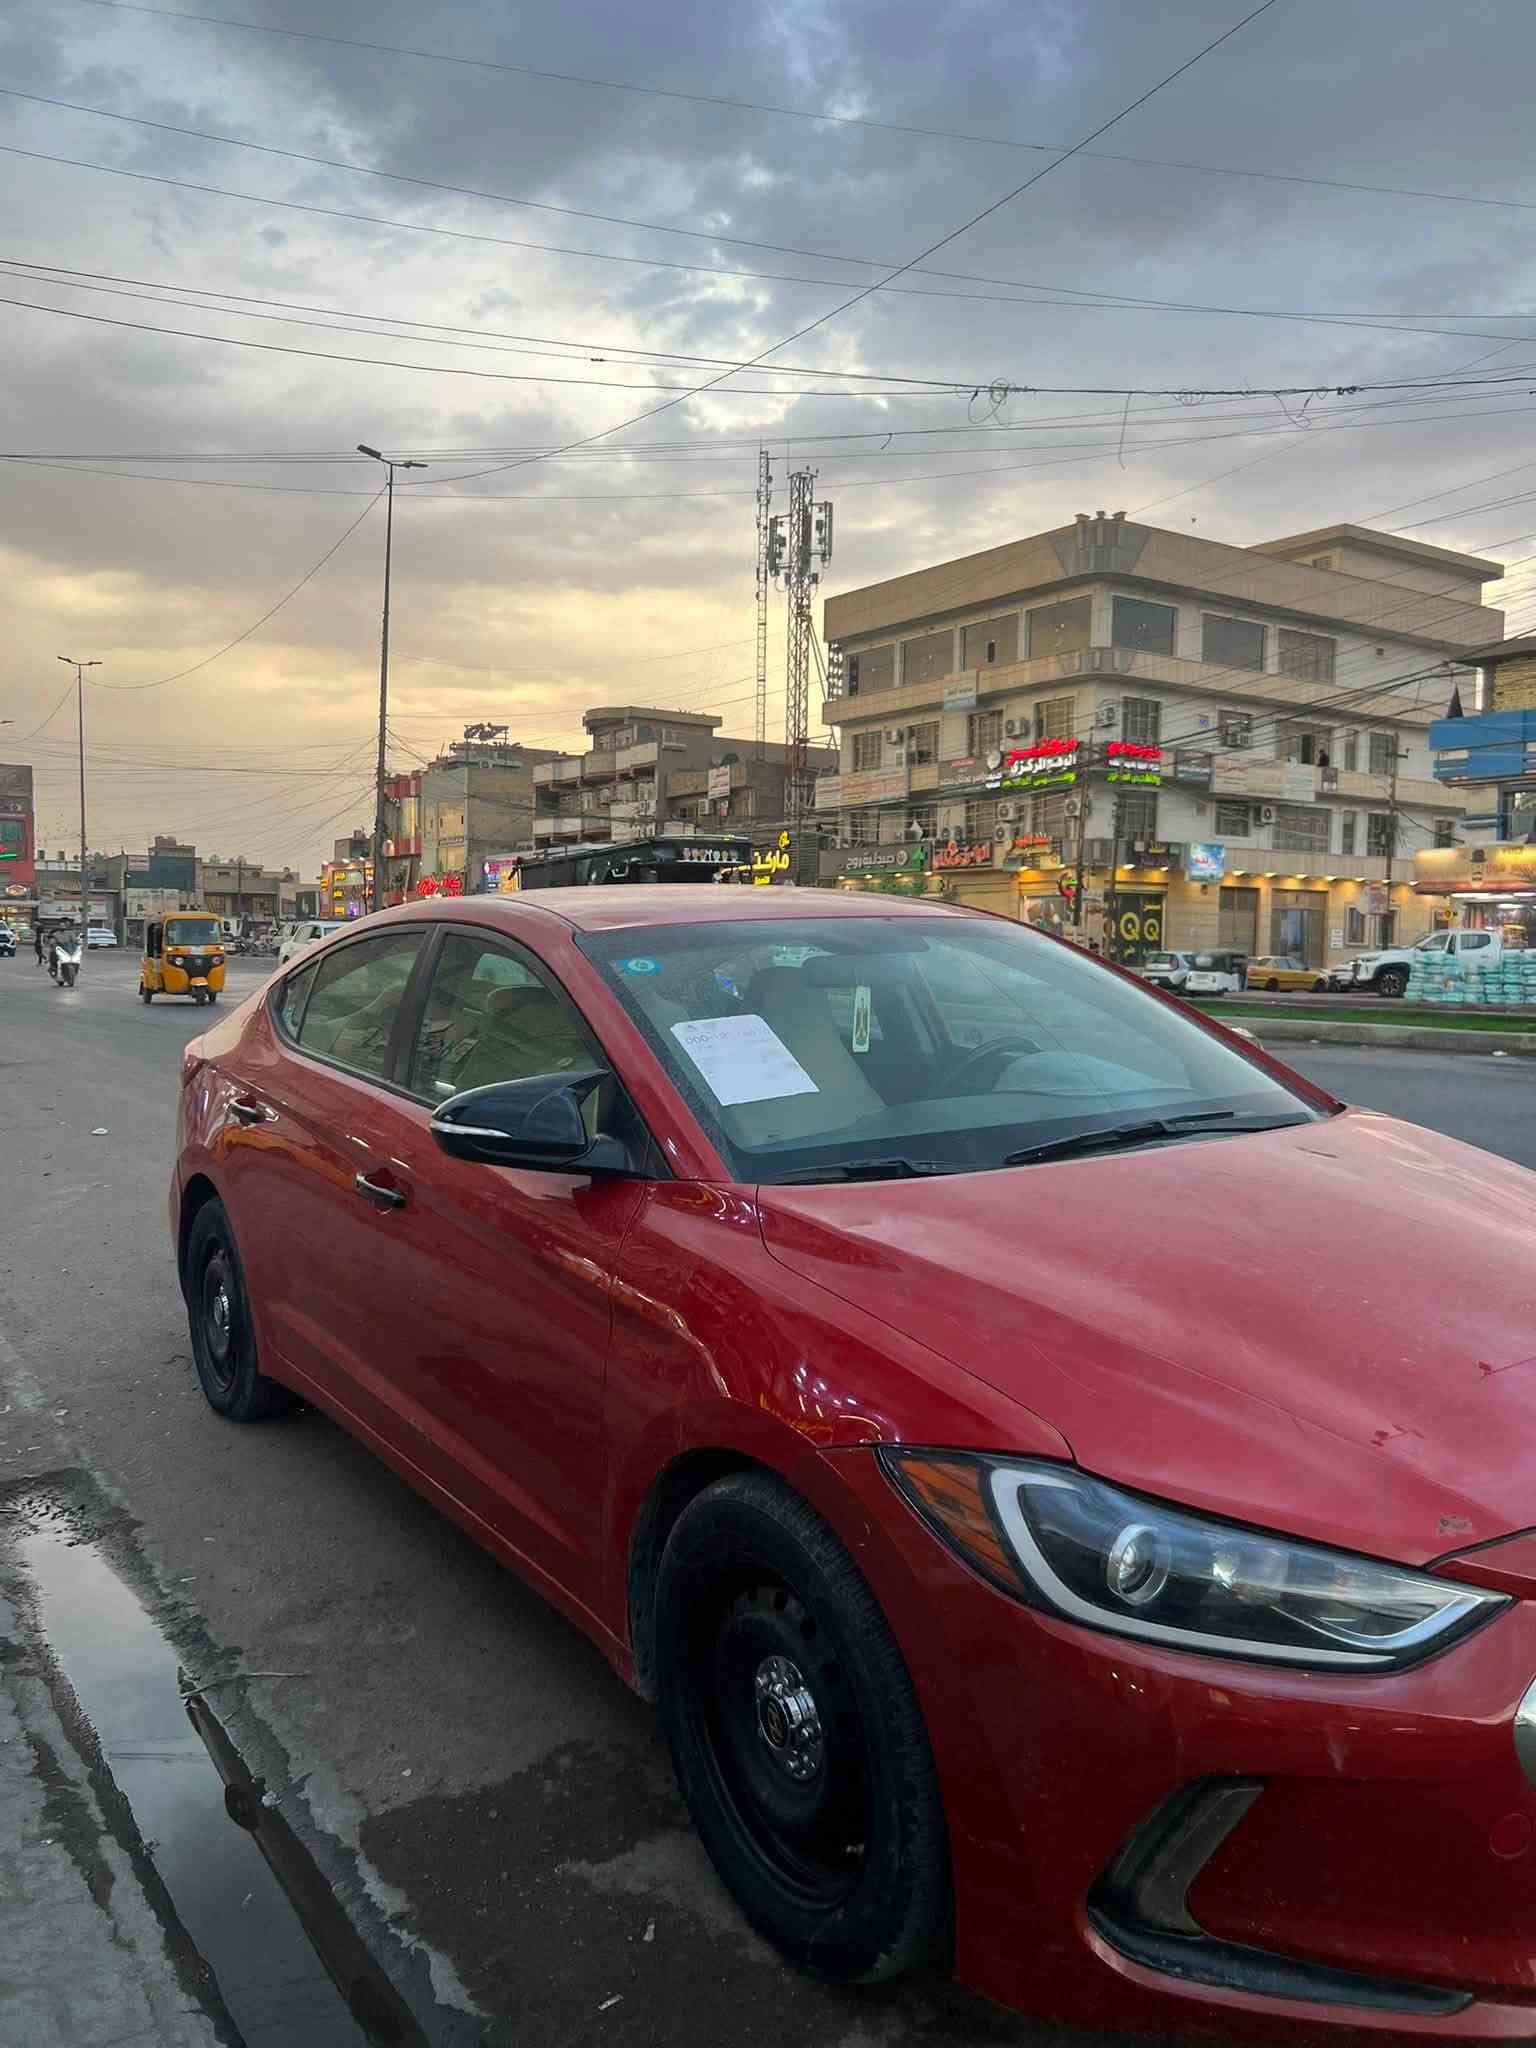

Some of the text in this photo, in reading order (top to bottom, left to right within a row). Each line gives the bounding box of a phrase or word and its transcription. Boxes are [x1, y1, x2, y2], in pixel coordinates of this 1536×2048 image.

[752, 849, 790, 873] ماركت
[863, 851, 895, 868] صيدلية
[1120, 912, 1140, 941] Q
[1143, 918, 1160, 941] Q
